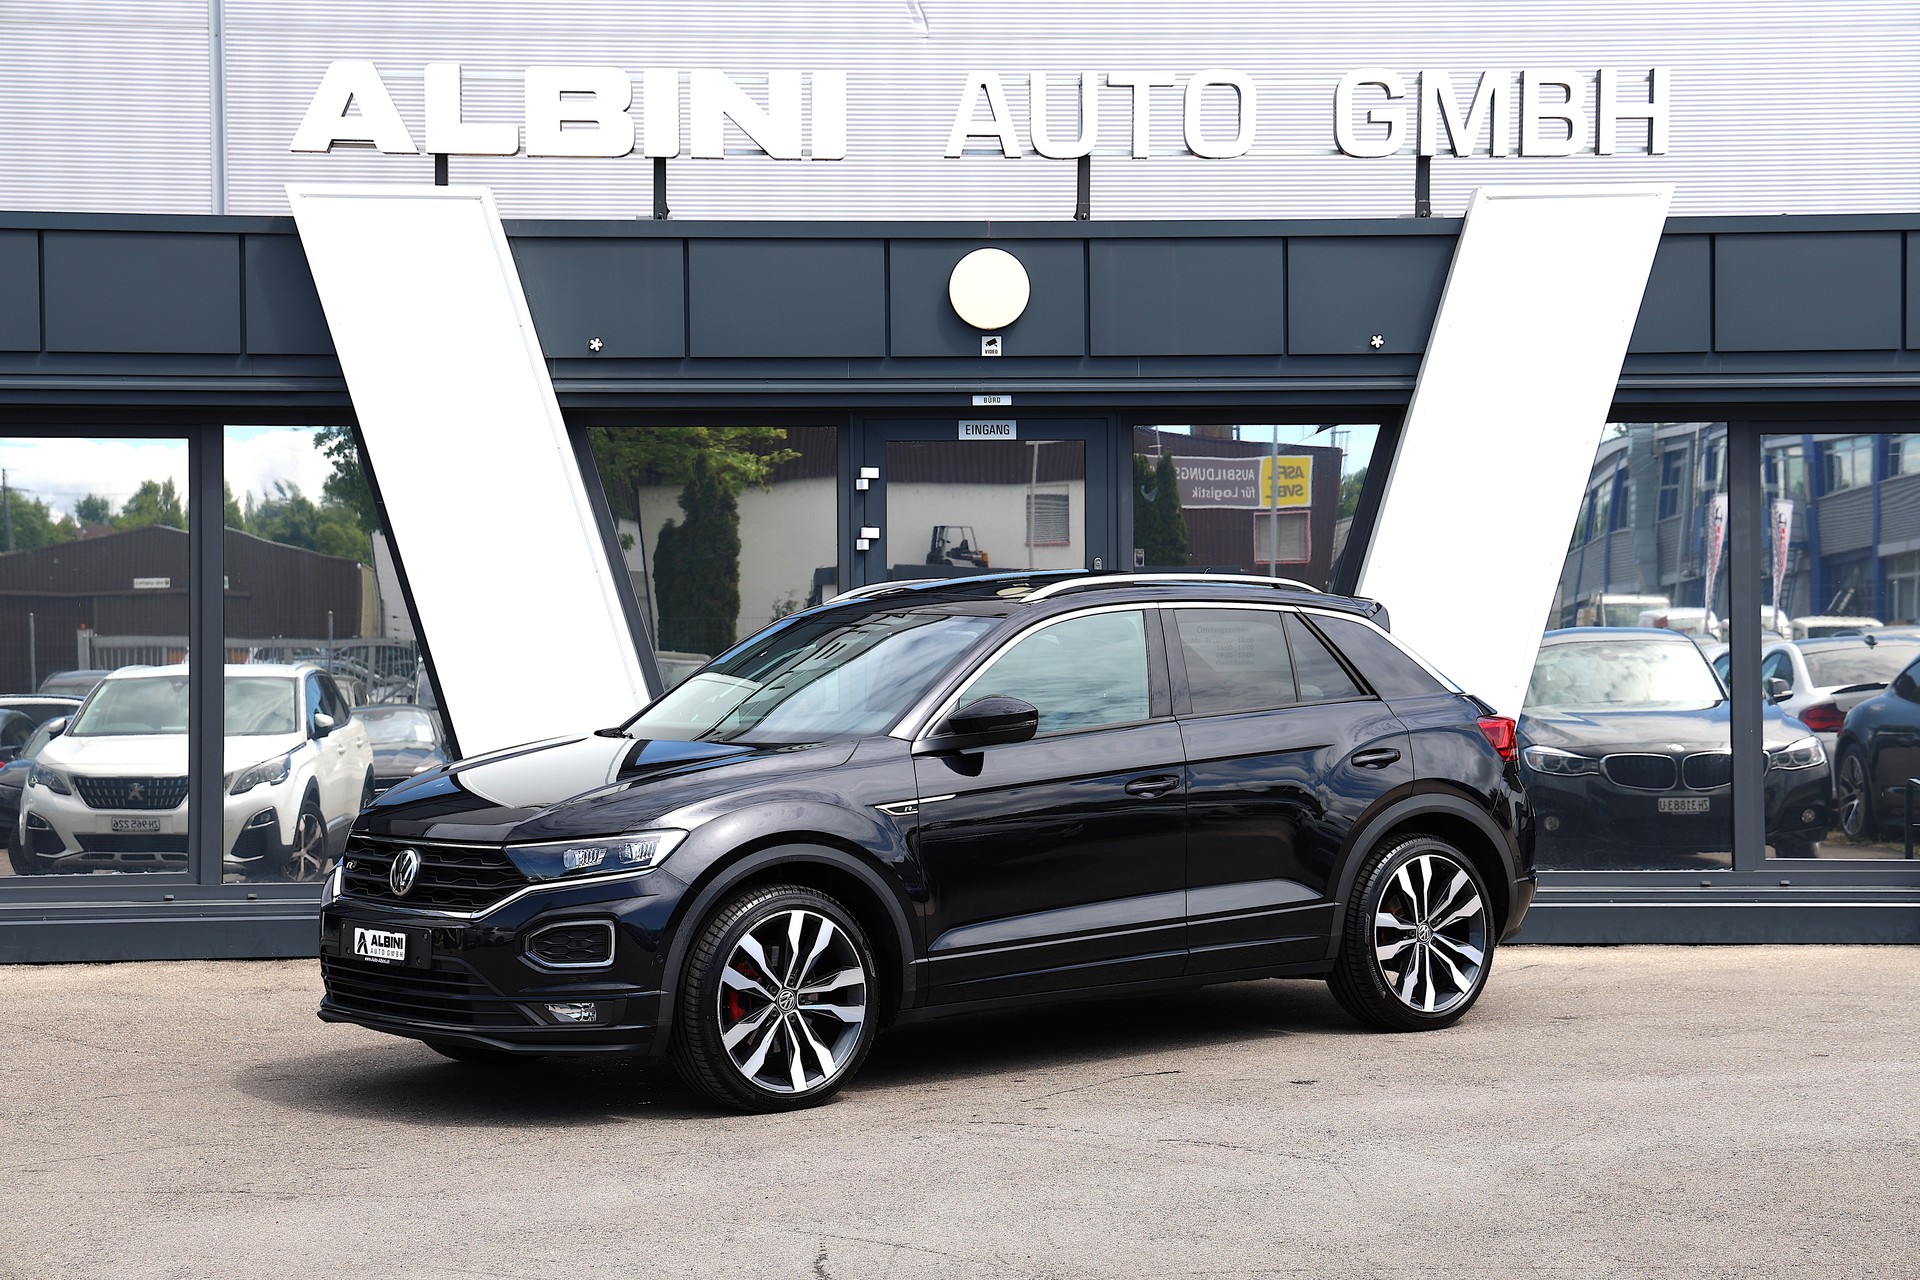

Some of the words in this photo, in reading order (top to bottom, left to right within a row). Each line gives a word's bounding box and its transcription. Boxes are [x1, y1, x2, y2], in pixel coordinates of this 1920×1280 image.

[290, 60, 847, 161] ALBINI
[944, 67, 1257, 160] AUTO
[1333, 67, 1672, 160] GMBH
[983, 395, 1001, 404] BÜRO
[965, 424, 1010, 435] EINGANG
[370, 934, 404, 950] ALBINI
[370, 948, 386, 956] AUTO
